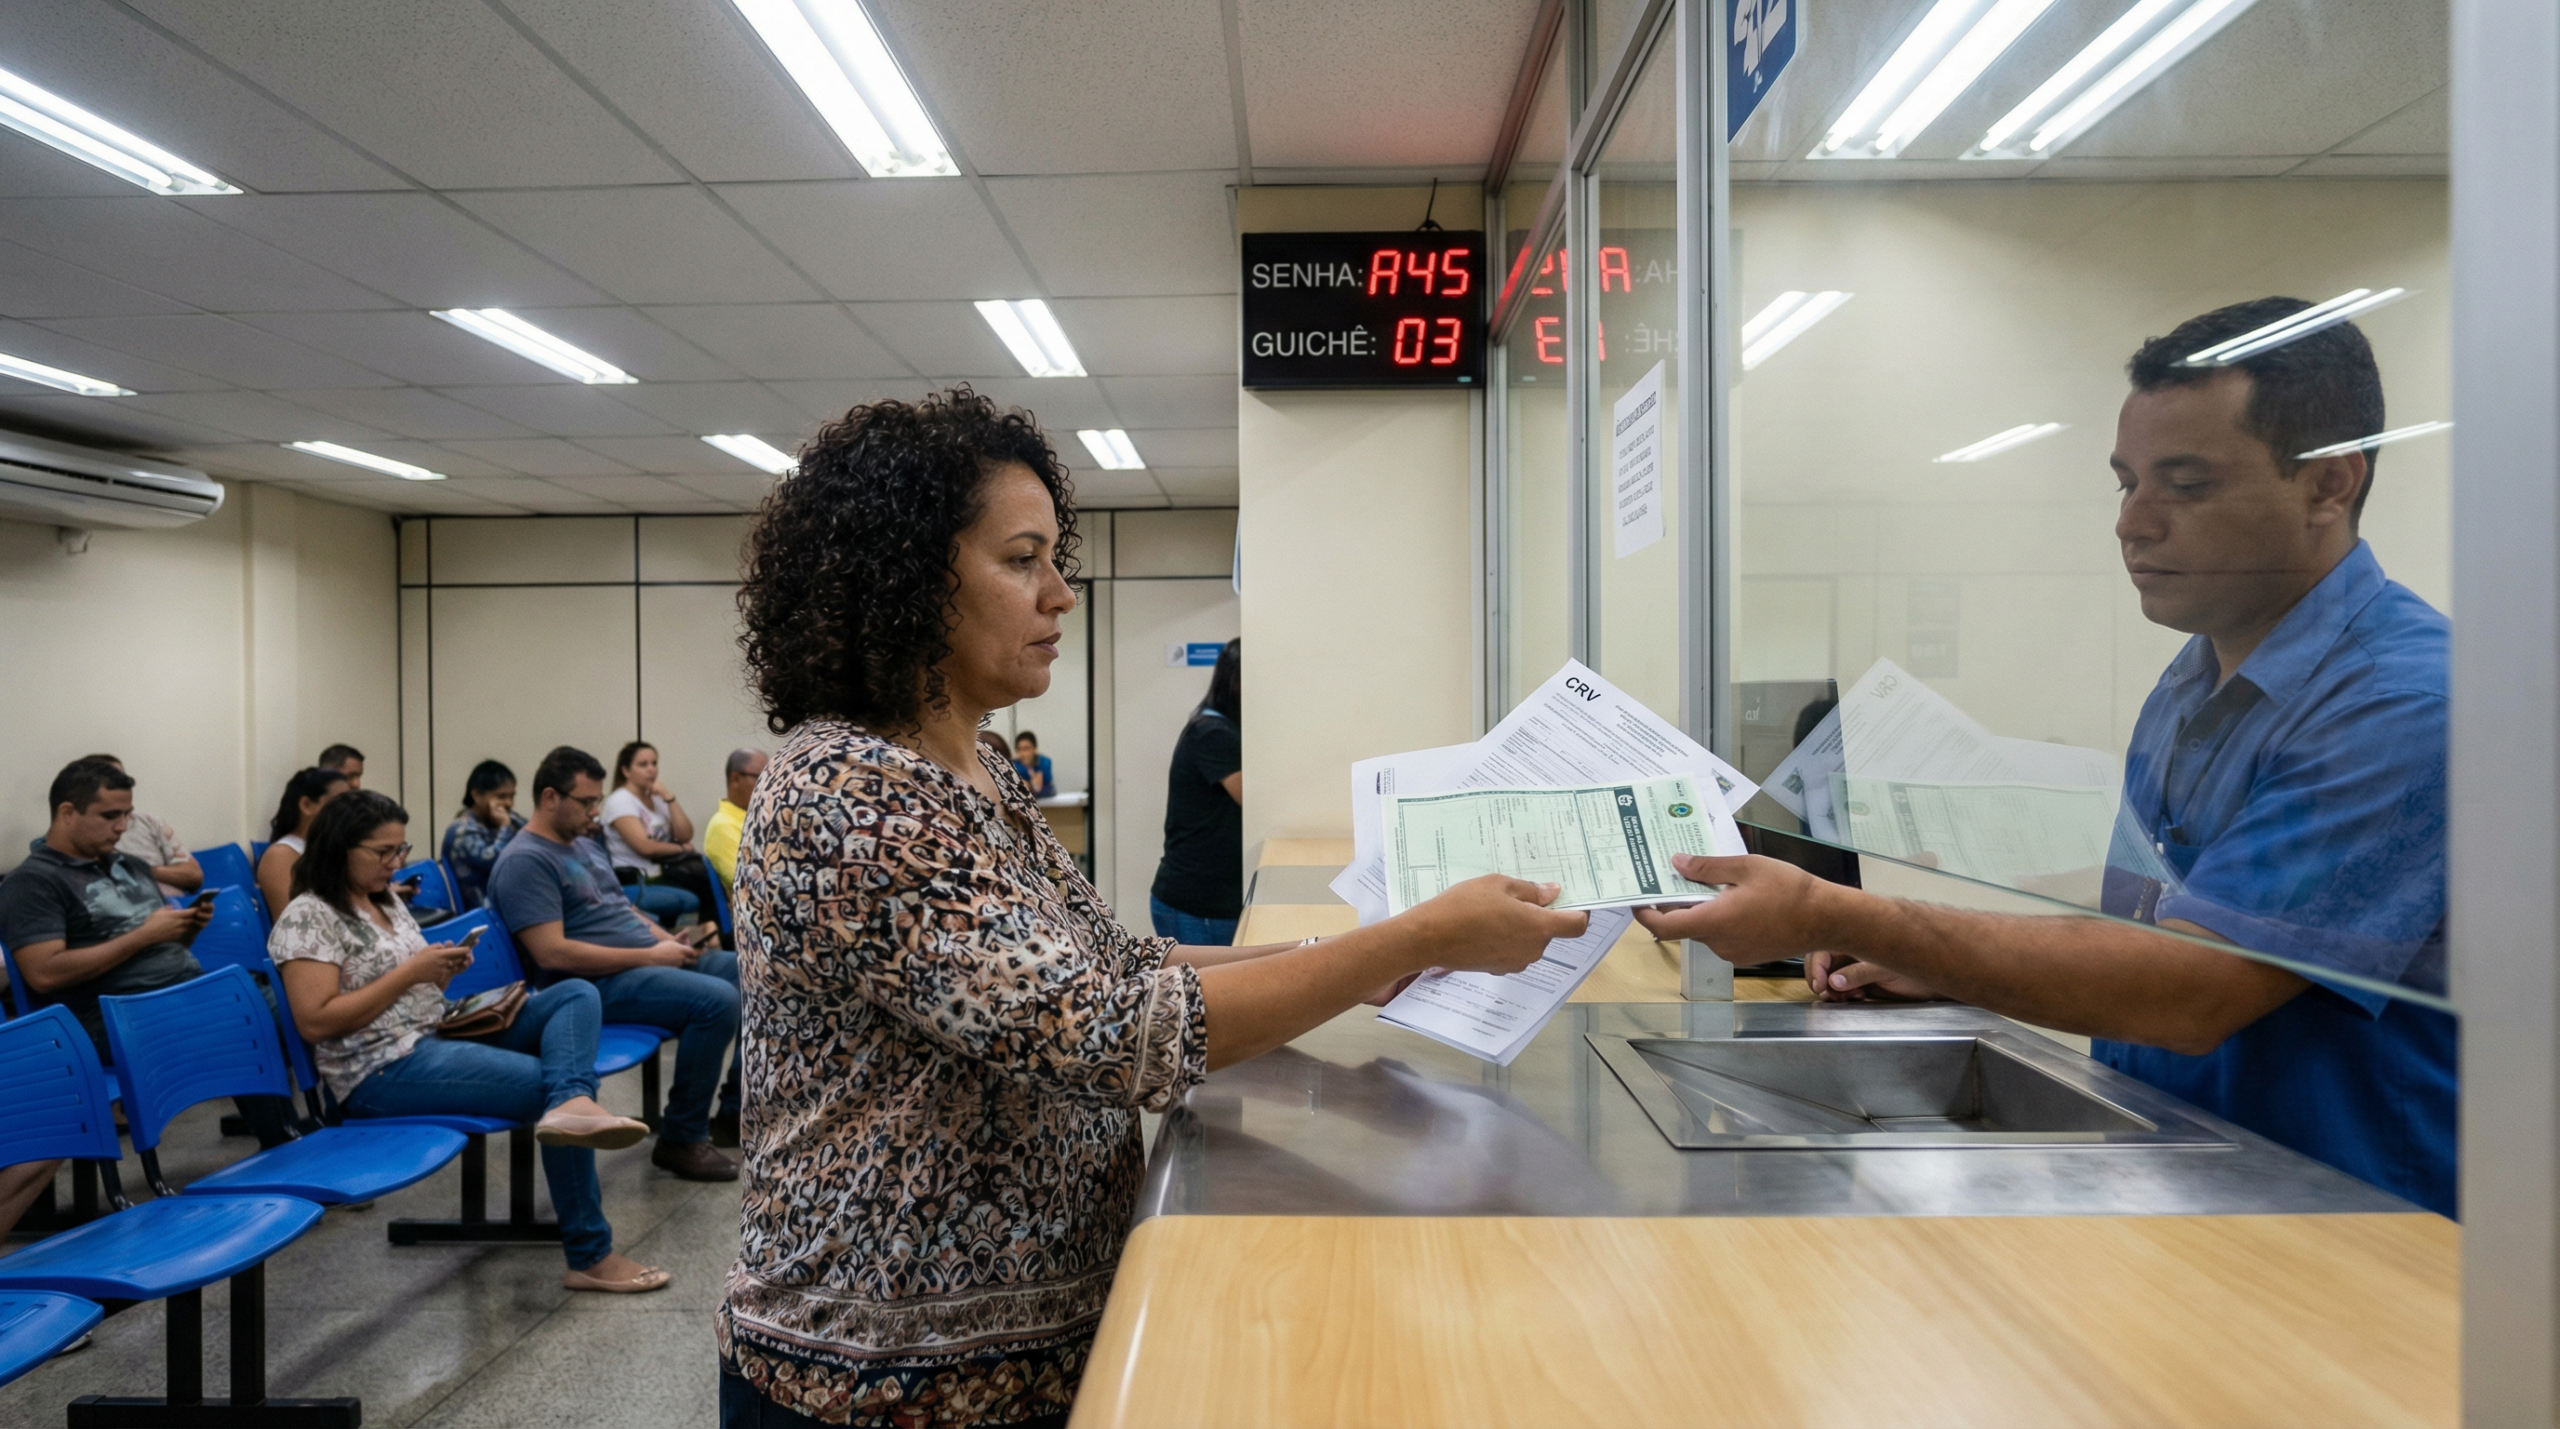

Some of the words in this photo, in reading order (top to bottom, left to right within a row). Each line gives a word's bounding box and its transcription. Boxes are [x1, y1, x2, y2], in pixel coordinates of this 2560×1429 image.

[1252, 262, 1363, 289] SENHA:
[1367, 247, 1471, 298] A45
[1251, 324, 1376, 357] GUICHÊ:
[1392, 316, 1463, 366] 03
[1565, 676, 1602, 703] CRV
